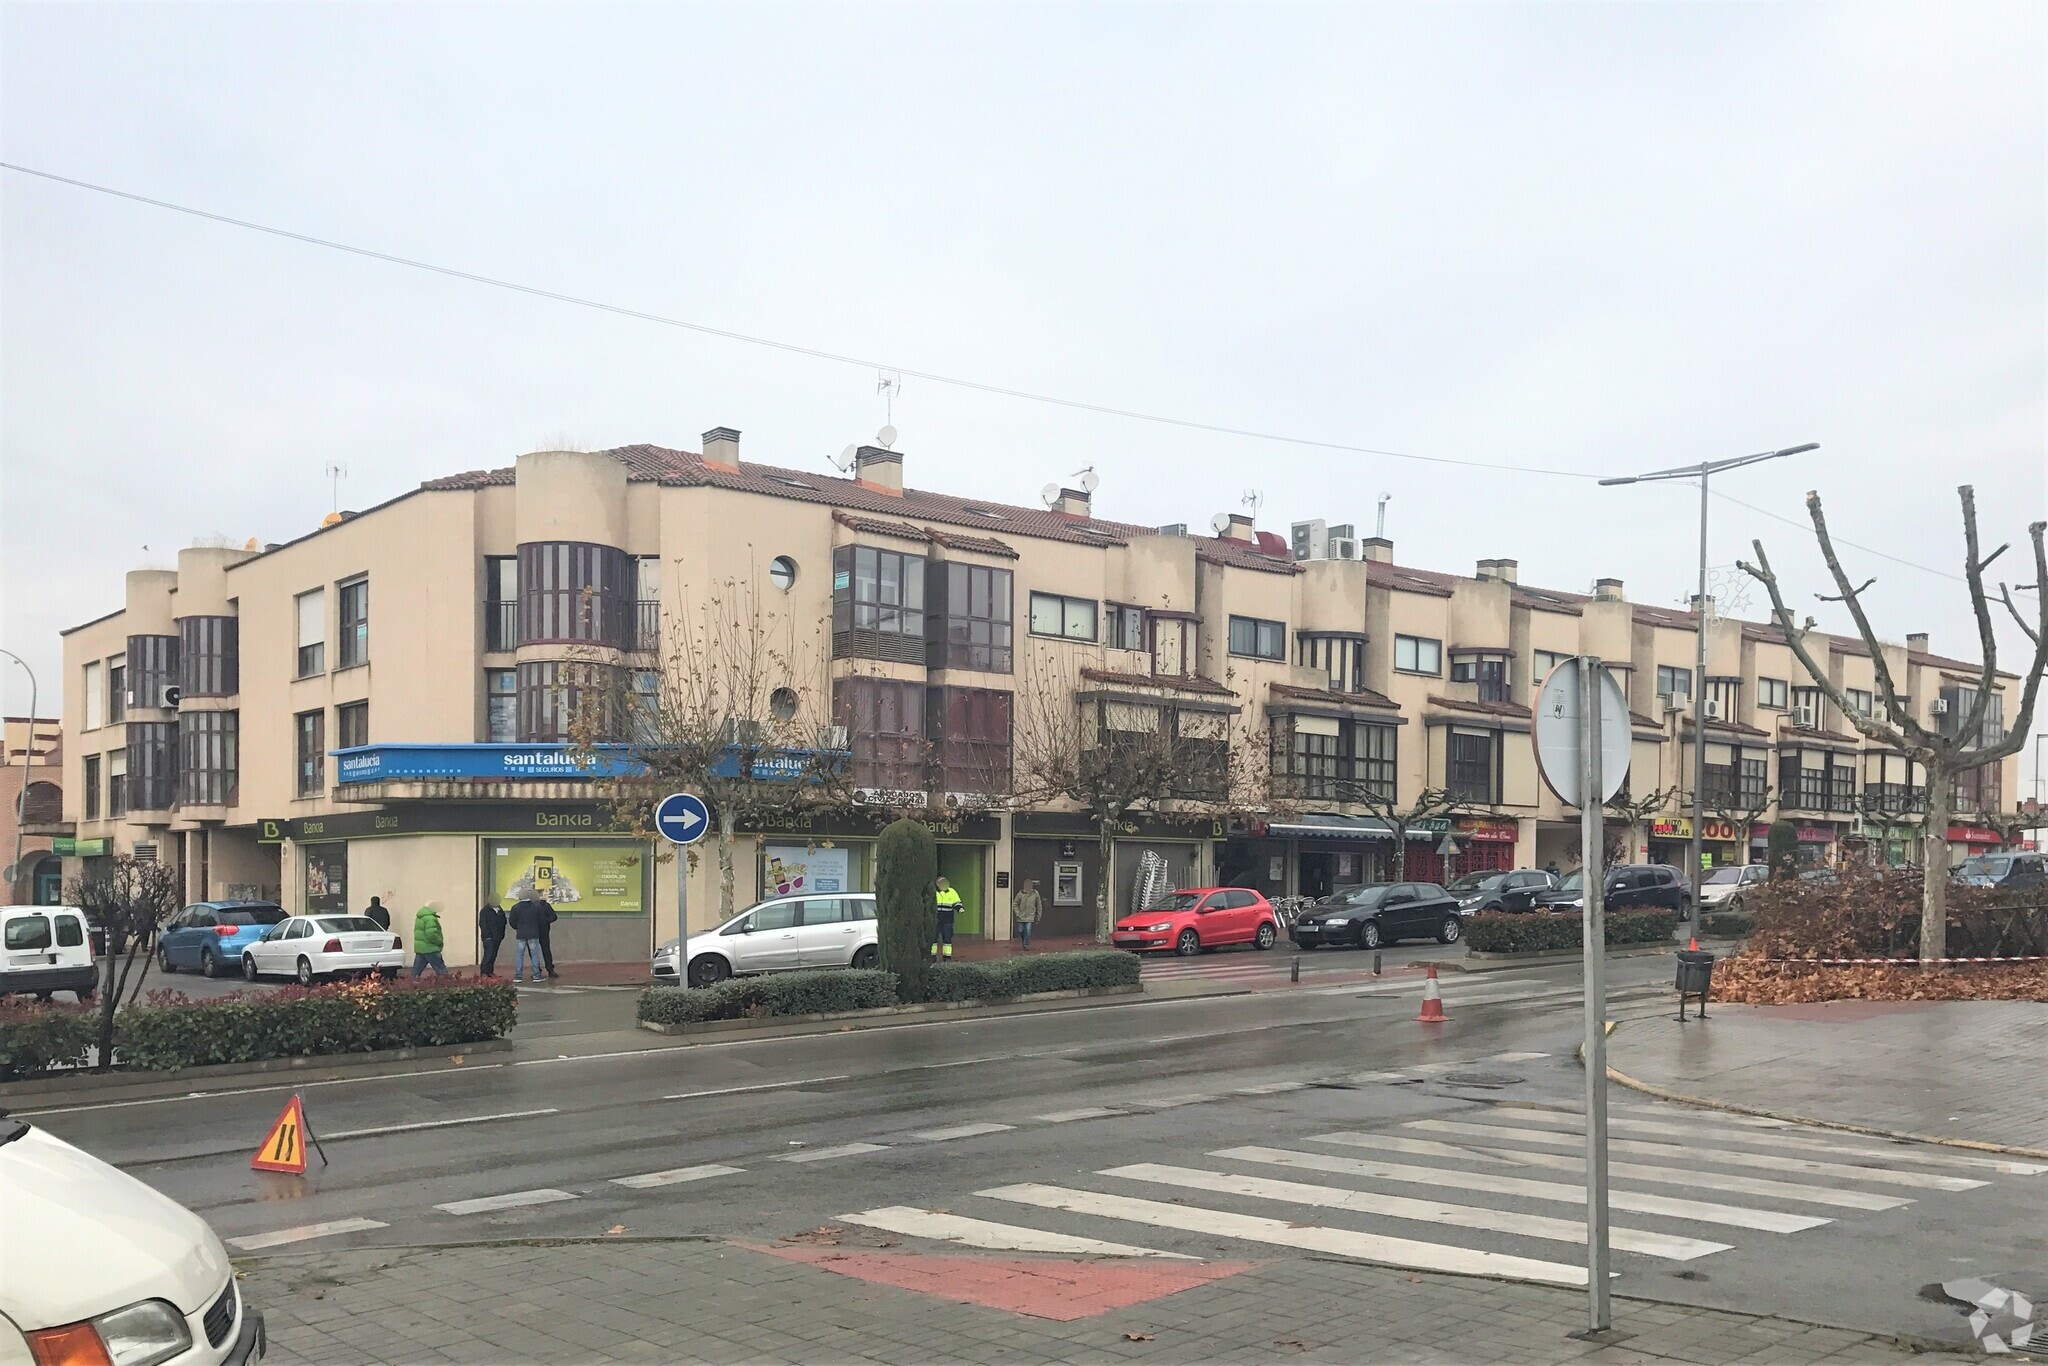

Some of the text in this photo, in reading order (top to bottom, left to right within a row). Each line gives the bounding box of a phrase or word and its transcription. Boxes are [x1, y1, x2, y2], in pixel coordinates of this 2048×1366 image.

[375, 815, 398, 829] Bankia
[536, 812, 592, 826] Bankia
[765, 814, 812, 829] Bankia
[1664, 819, 1683, 827] AUTO
[263, 821, 280, 838] B
[303, 822, 324, 834] Bankia
[1212, 821, 1223, 836] B
